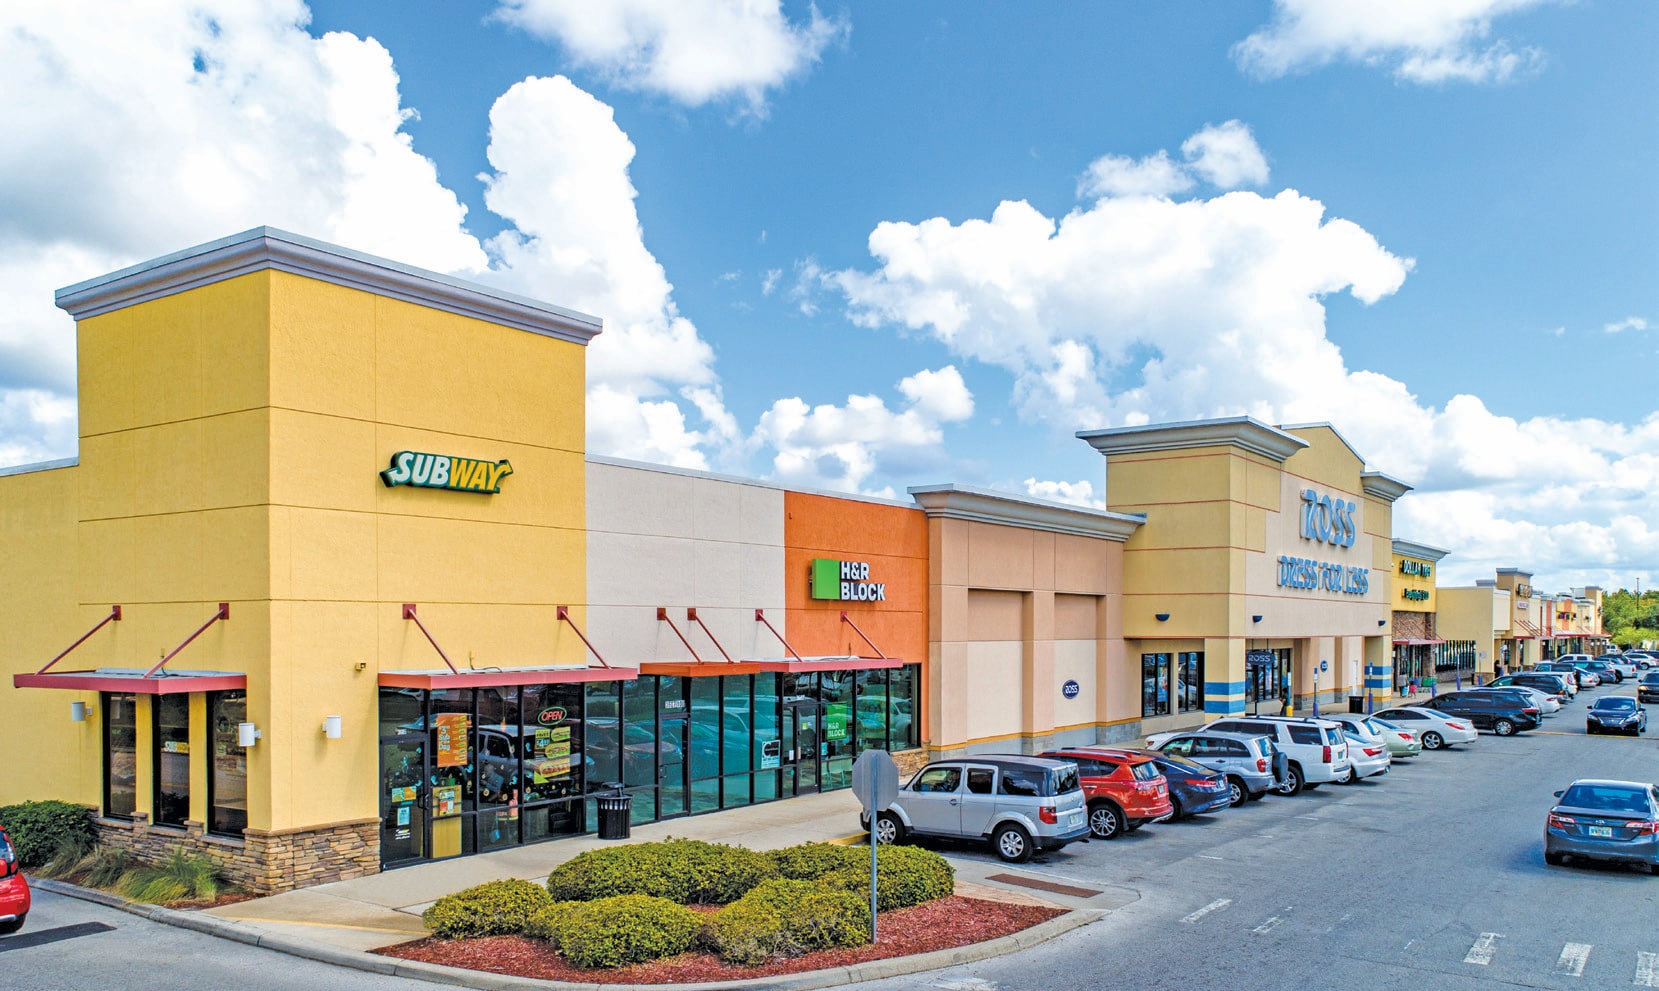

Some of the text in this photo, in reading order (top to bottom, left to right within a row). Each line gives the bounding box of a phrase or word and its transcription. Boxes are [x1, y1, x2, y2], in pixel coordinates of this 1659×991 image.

[388, 451, 513, 491] SUBWAY
[1299, 489, 1356, 548] ROSS
[841, 561, 870, 580] H&R
[1277, 555, 1369, 594] DRESS FOR LESS
[841, 582, 886, 601] BLOCK
[1248, 654, 1271, 662] ROSS
[1065, 685, 1078, 693] ROSS
[541, 710, 563, 721] OPEN
